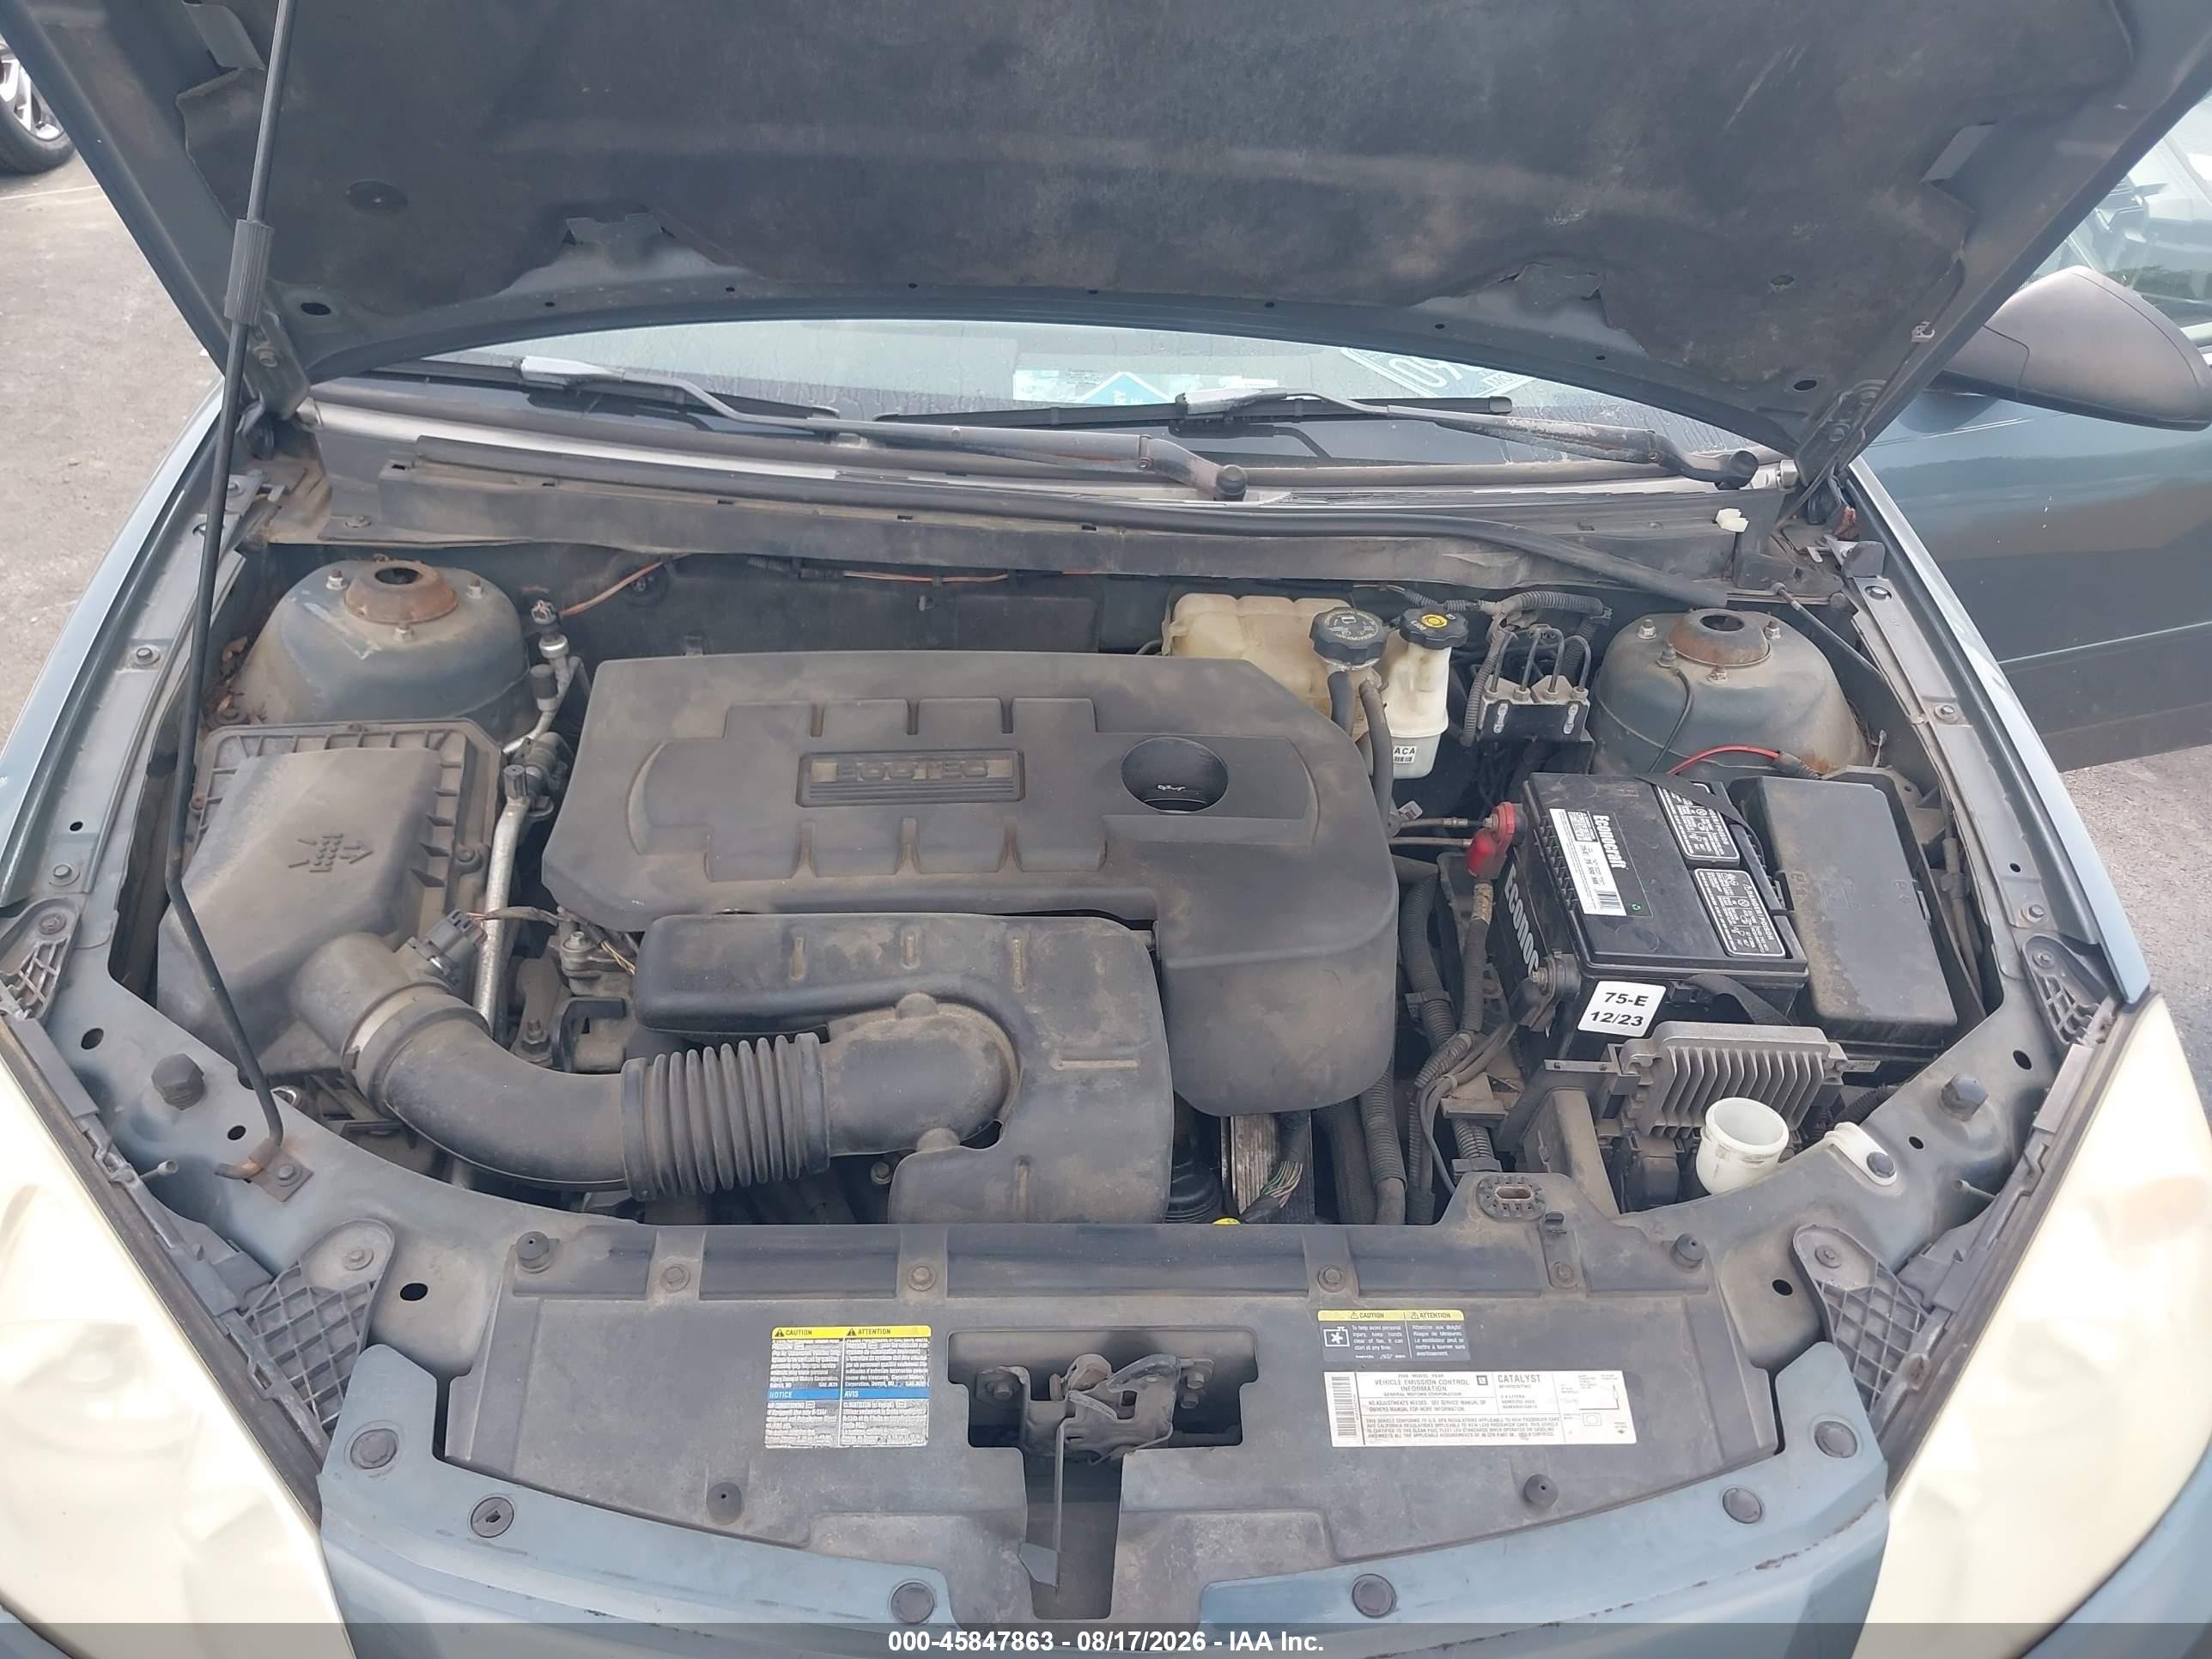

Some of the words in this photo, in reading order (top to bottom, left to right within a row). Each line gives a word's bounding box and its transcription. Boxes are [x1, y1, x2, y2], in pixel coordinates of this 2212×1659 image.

[1592, 815, 1626, 869] Econocraft
[1604, 992, 1650, 1007] 75-E
[1590, 1011, 1644, 1027] 12/23
[1498, 1374, 1540, 1382] CATALYST
